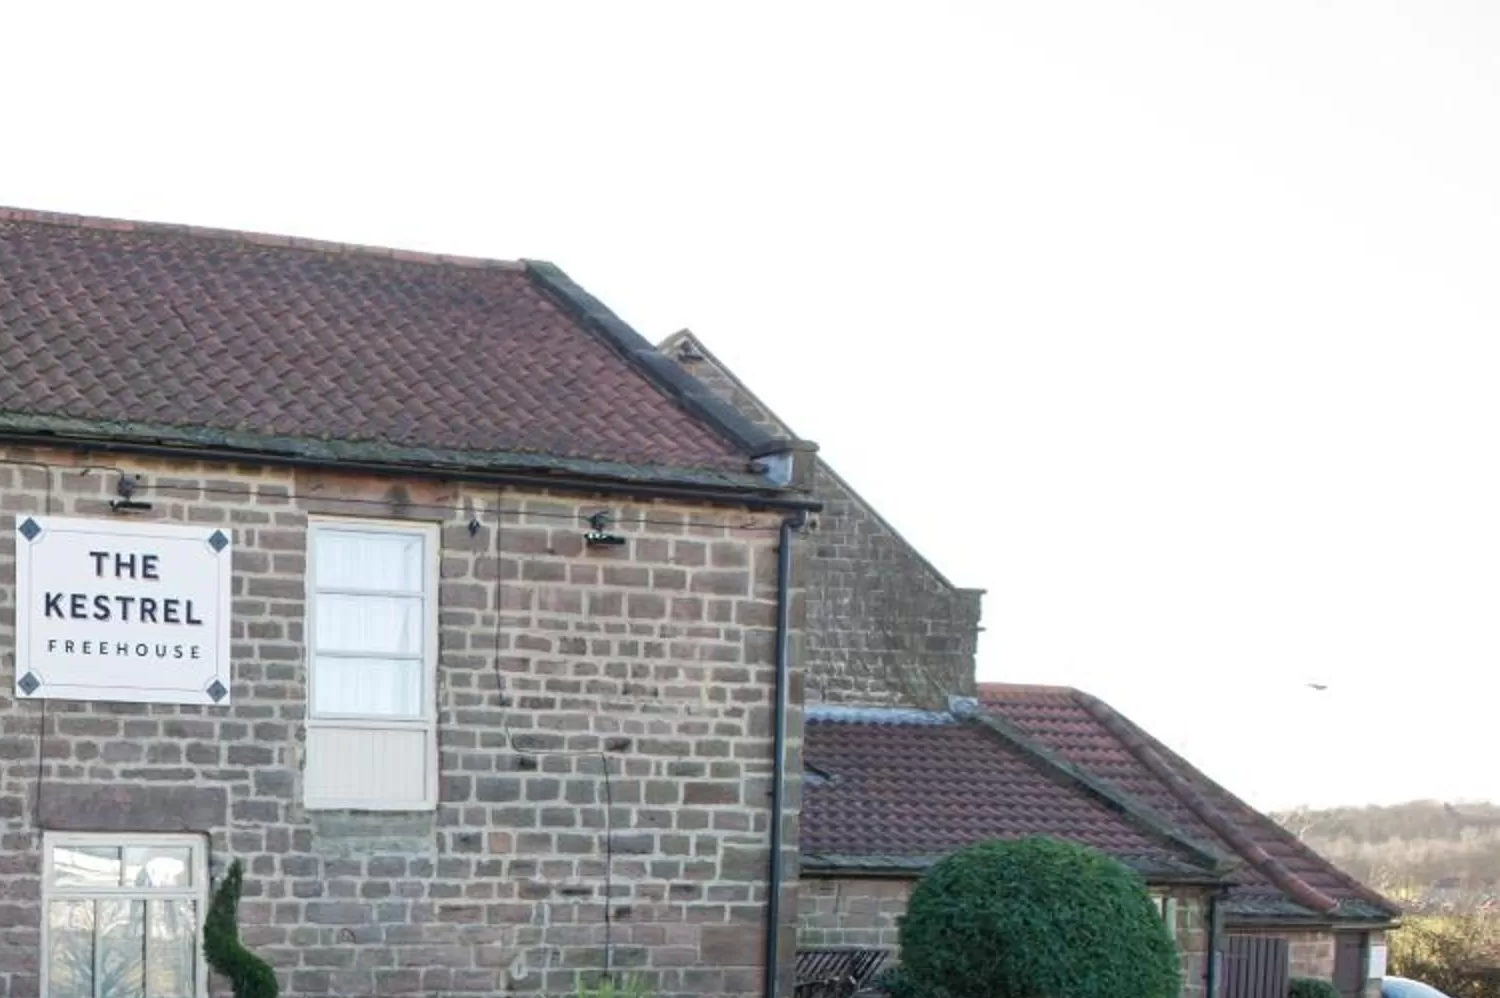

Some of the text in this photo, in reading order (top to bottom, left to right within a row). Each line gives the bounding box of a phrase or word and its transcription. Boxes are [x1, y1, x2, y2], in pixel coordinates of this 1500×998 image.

[90, 551, 160, 579] THE
[45, 592, 203, 625] KESTREL
[47, 639, 201, 659] FREEHOUSE
